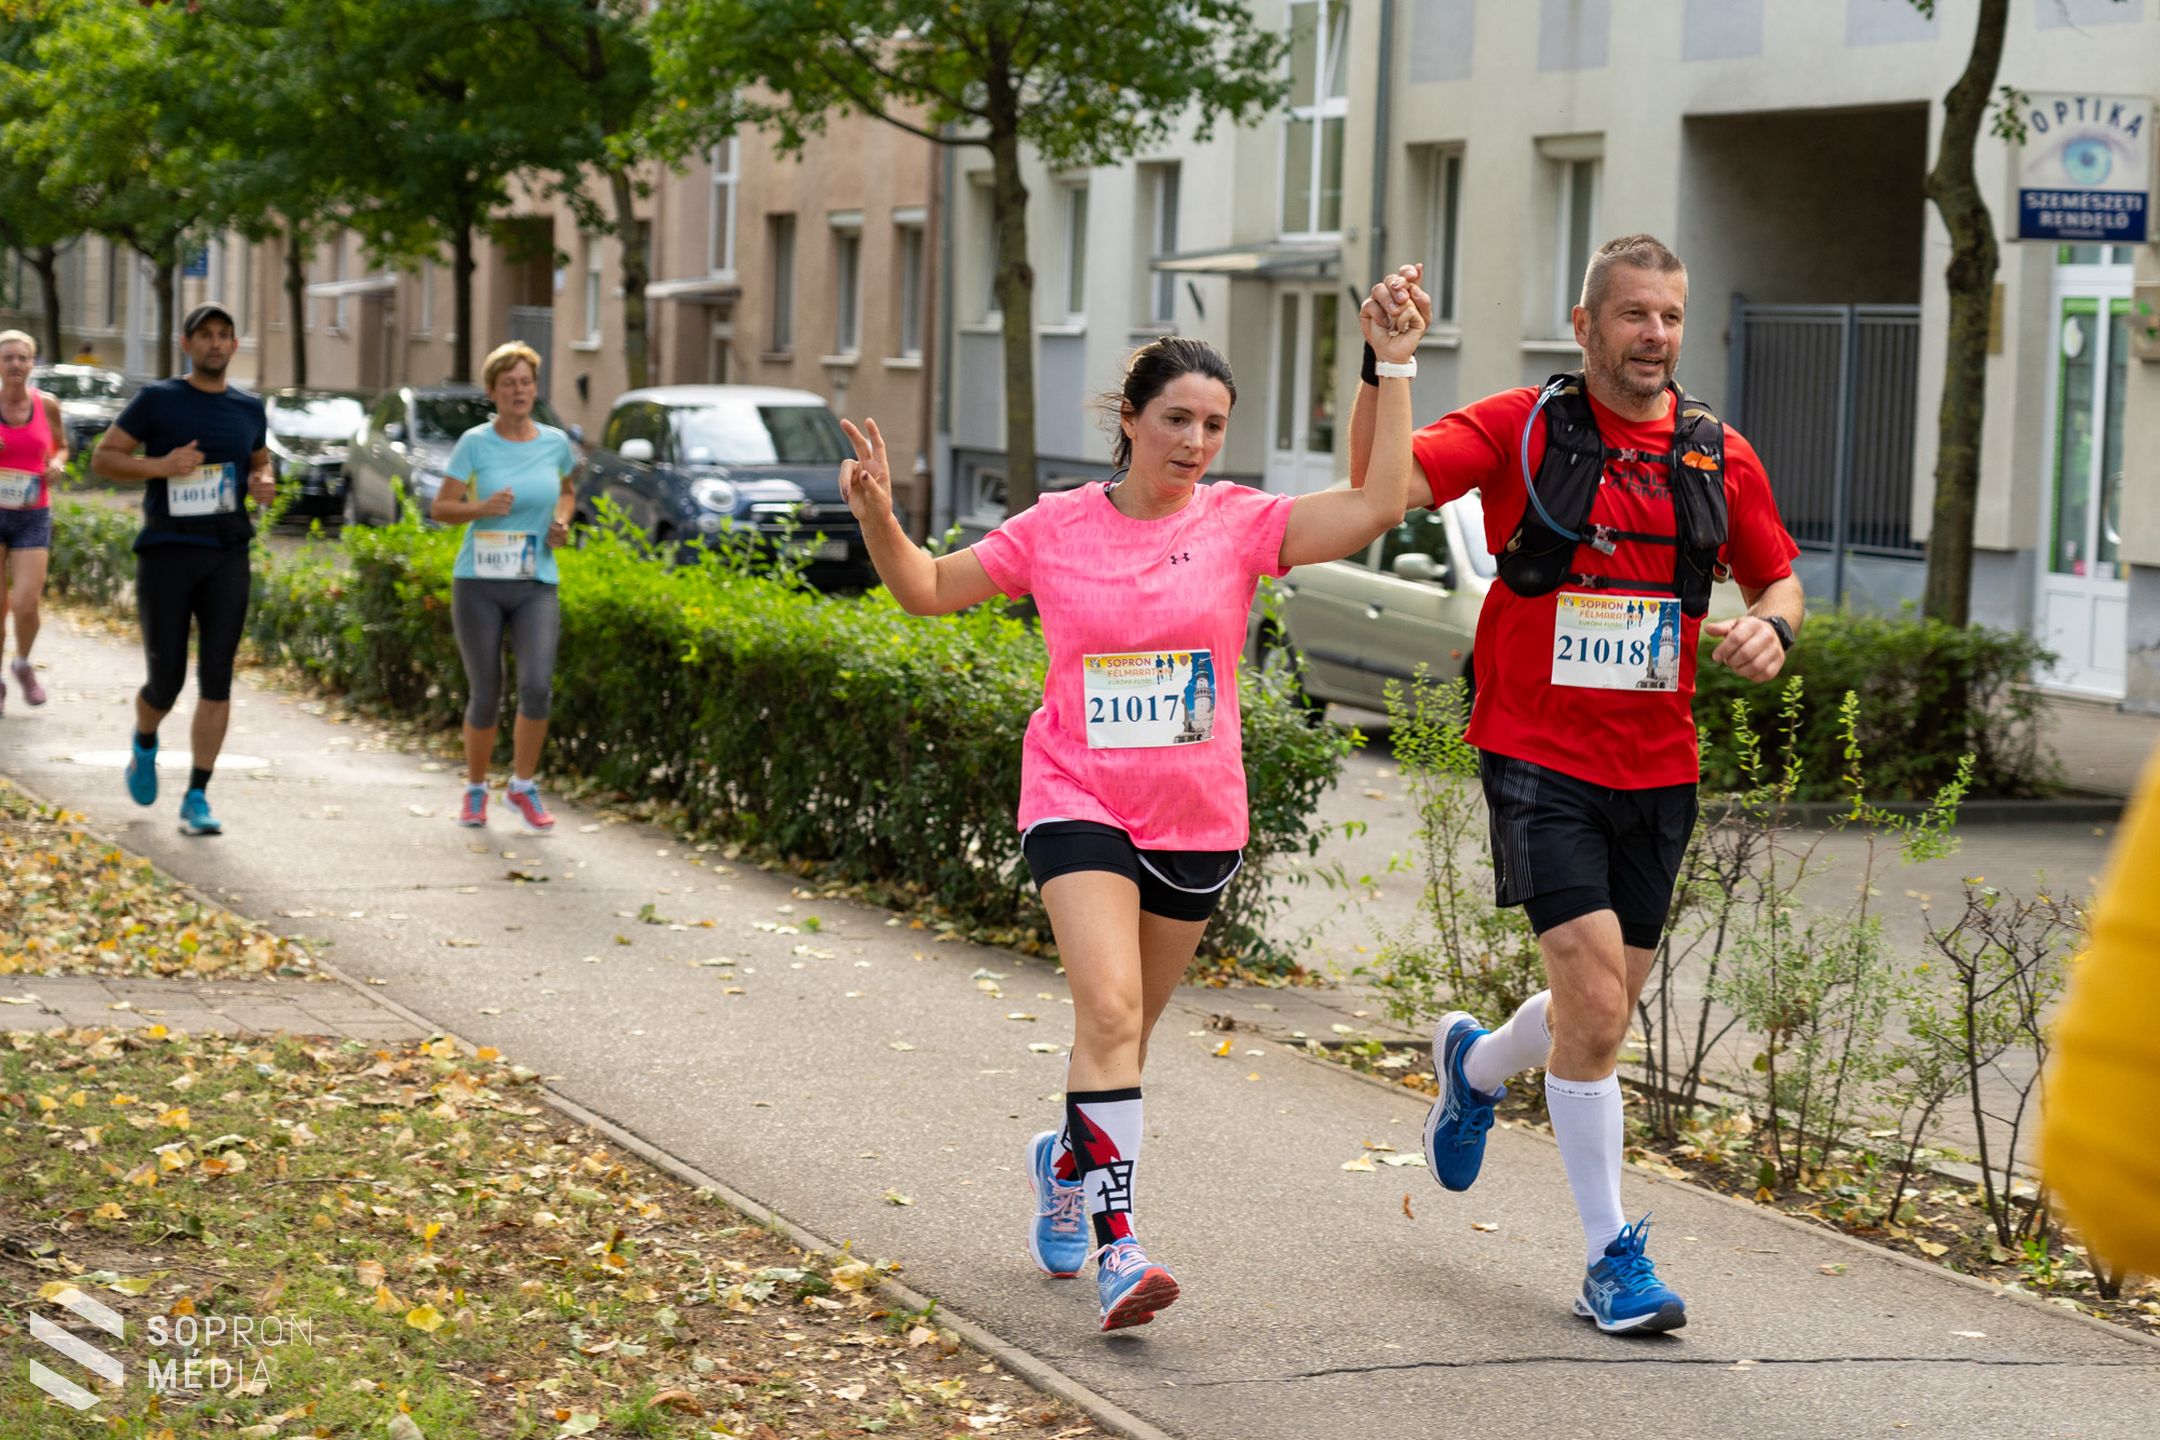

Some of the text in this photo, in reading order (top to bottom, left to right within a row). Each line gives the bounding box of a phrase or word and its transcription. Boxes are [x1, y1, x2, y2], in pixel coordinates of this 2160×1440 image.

[2030, 97, 2143, 138] OPTIKA
[2024, 190, 2143, 212] SZEMÉSZETI
[172, 488, 216, 502] 14014
[476, 551, 518, 565] 14037
[1580, 599, 1624, 611] SOPRON
[1557, 635, 1646, 666] 21018
[1107, 657, 1151, 668] SOPRON
[1089, 694, 1180, 724] 21017
